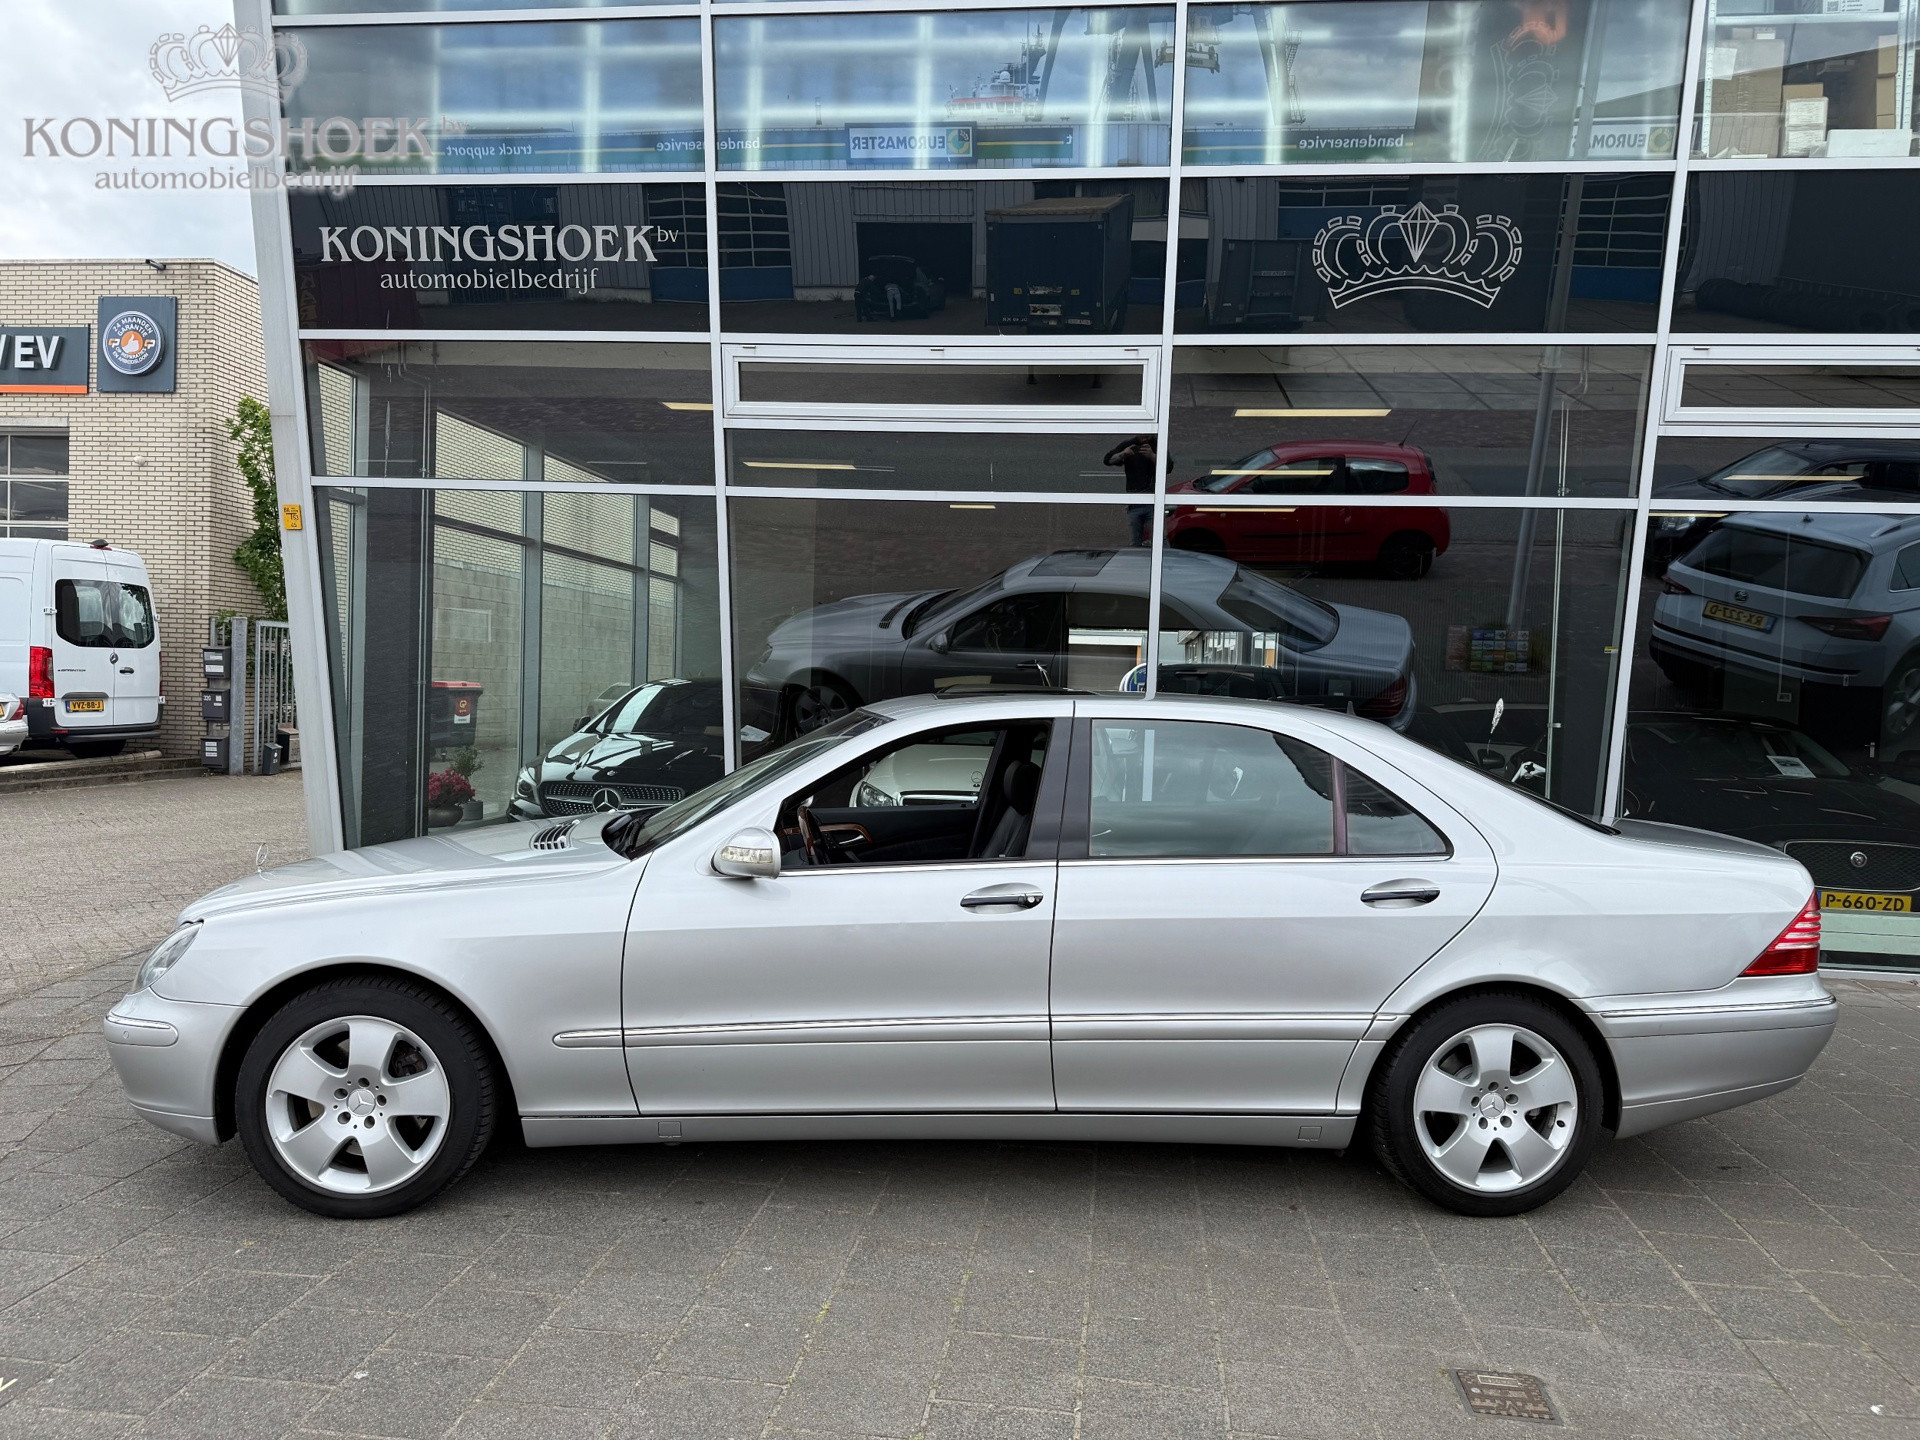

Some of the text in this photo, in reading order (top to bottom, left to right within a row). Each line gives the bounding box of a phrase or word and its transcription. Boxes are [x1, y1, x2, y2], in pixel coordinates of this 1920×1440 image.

[318, 224, 679, 263] KONINGSHOEK bv
[380, 267, 600, 295] automobielbedrijf
[113, 317, 153, 333] 24 MAANDEN
[118, 324, 148, 337] GARANTIE
[1825, 894, 1905, 912] P-660-ZD
